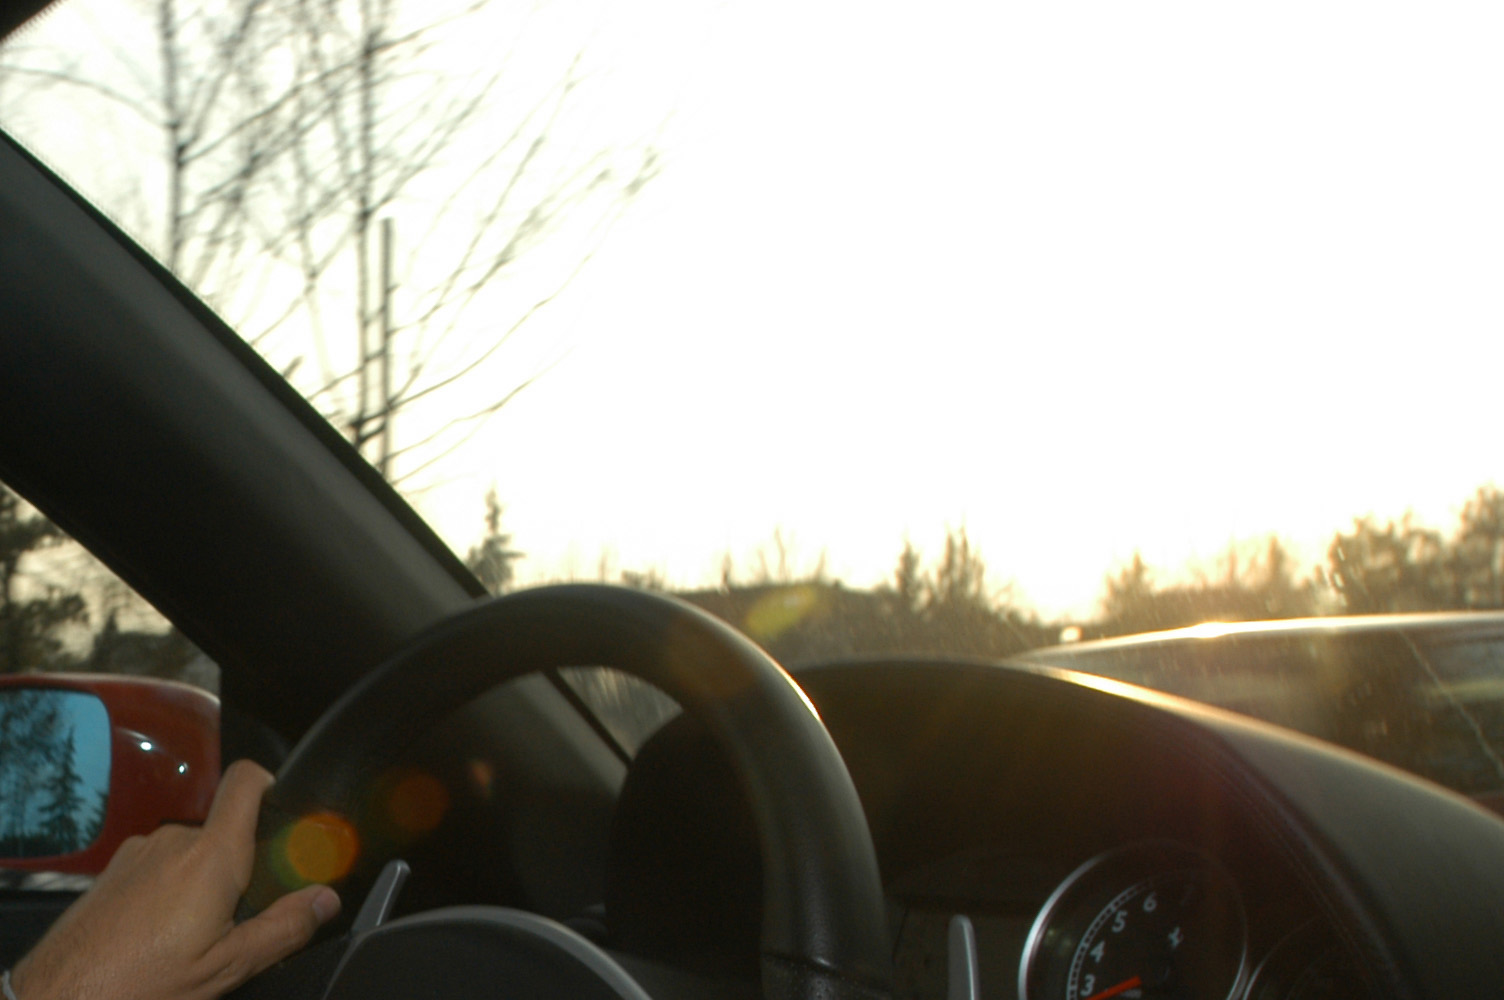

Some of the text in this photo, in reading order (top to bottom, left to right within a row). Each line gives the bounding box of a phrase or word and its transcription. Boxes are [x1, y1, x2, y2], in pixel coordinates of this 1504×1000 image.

[1142, 891, 1157, 912] 6
[1111, 909, 1128, 933] 5
[1090, 940, 1105, 963] 4
[1080, 974, 1096, 997] 3
